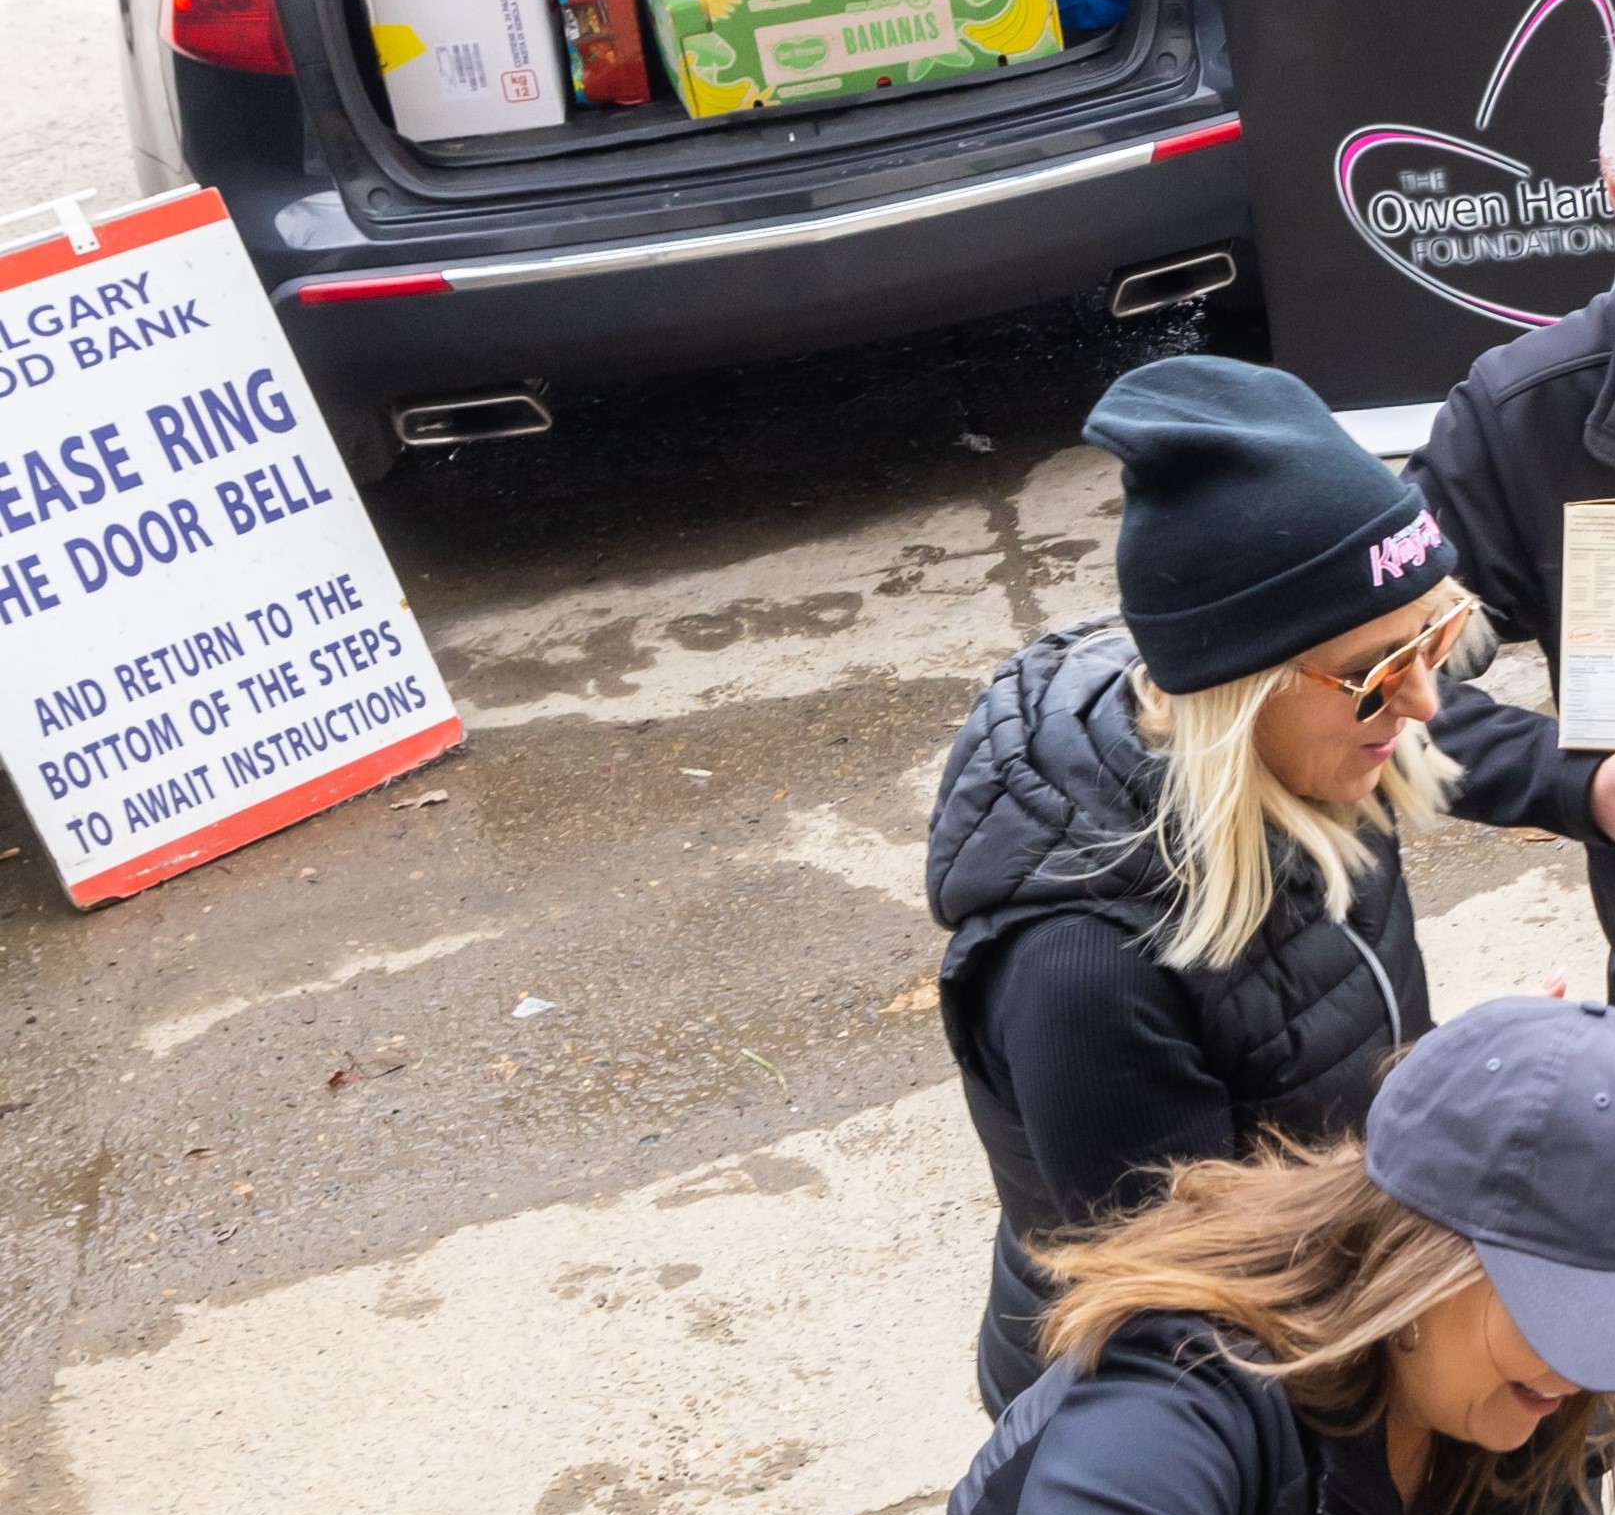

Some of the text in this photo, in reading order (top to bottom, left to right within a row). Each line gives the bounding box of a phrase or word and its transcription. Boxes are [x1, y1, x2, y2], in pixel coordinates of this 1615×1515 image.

[841, 12, 940, 56] BANANAS
[1370, 178, 1615, 235] Owen Hart
[76, 298, 212, 372] BANK
[146, 367, 298, 474] RING
[63, 496, 214, 596] DOOR
[214, 454, 333, 538] BELL
[33, 572, 364, 738] AND RETURN TO THE
[38, 619, 404, 803] BOTTOM OF THE STEPS
[65, 674, 429, 856] TO AWAIT INSTRUCTIONS
